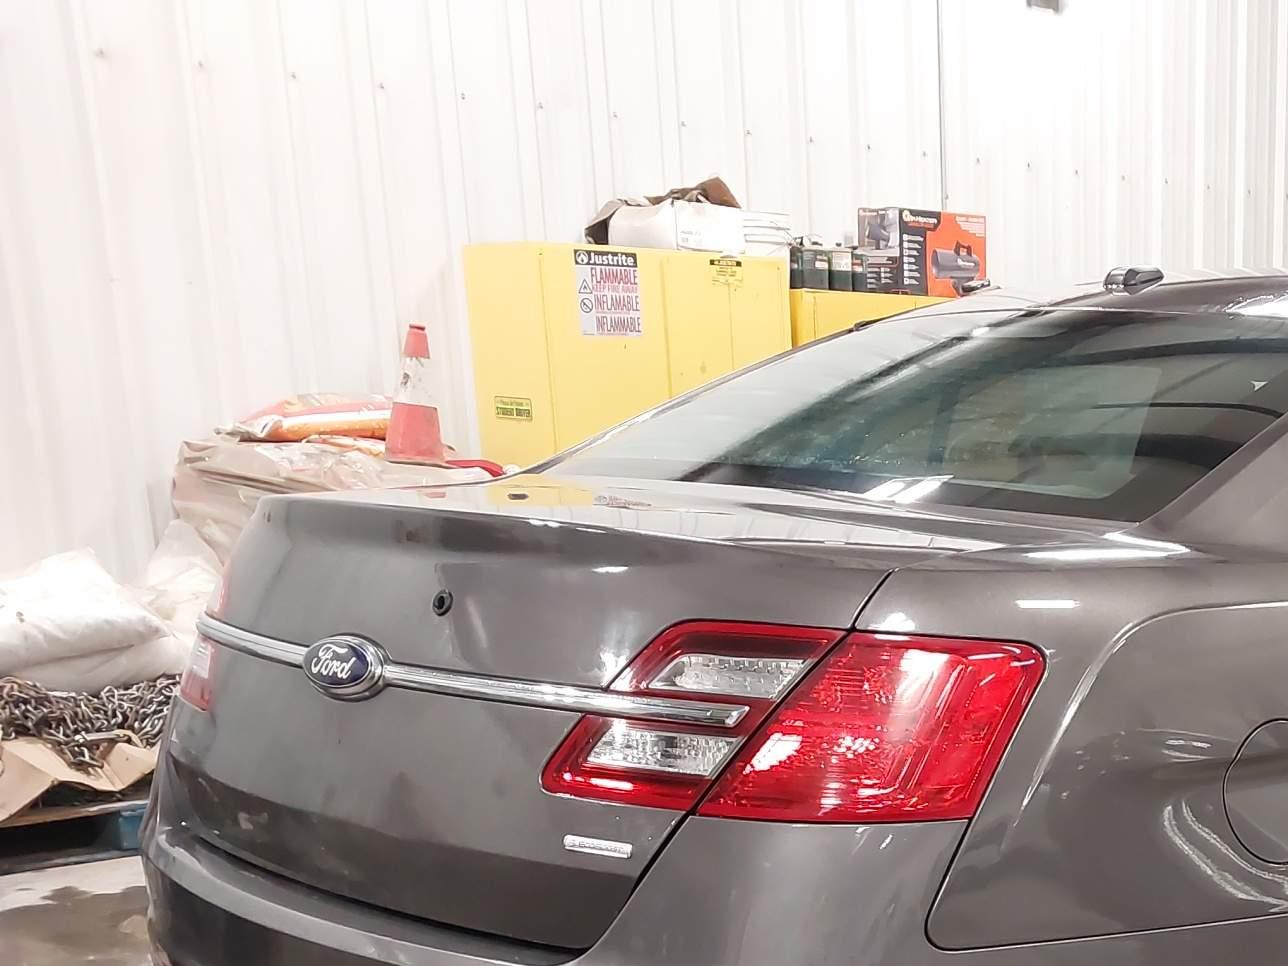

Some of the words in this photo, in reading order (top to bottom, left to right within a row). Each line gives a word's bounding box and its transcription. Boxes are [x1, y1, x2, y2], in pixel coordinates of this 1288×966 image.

[589, 252, 635, 266] Justrite
[590, 267, 638, 285] FLAMMABLE
[594, 294, 640, 312] INFLAMABLE
[596, 316, 642, 333] INFLAMMABLE
[311, 643, 357, 680] Ford
